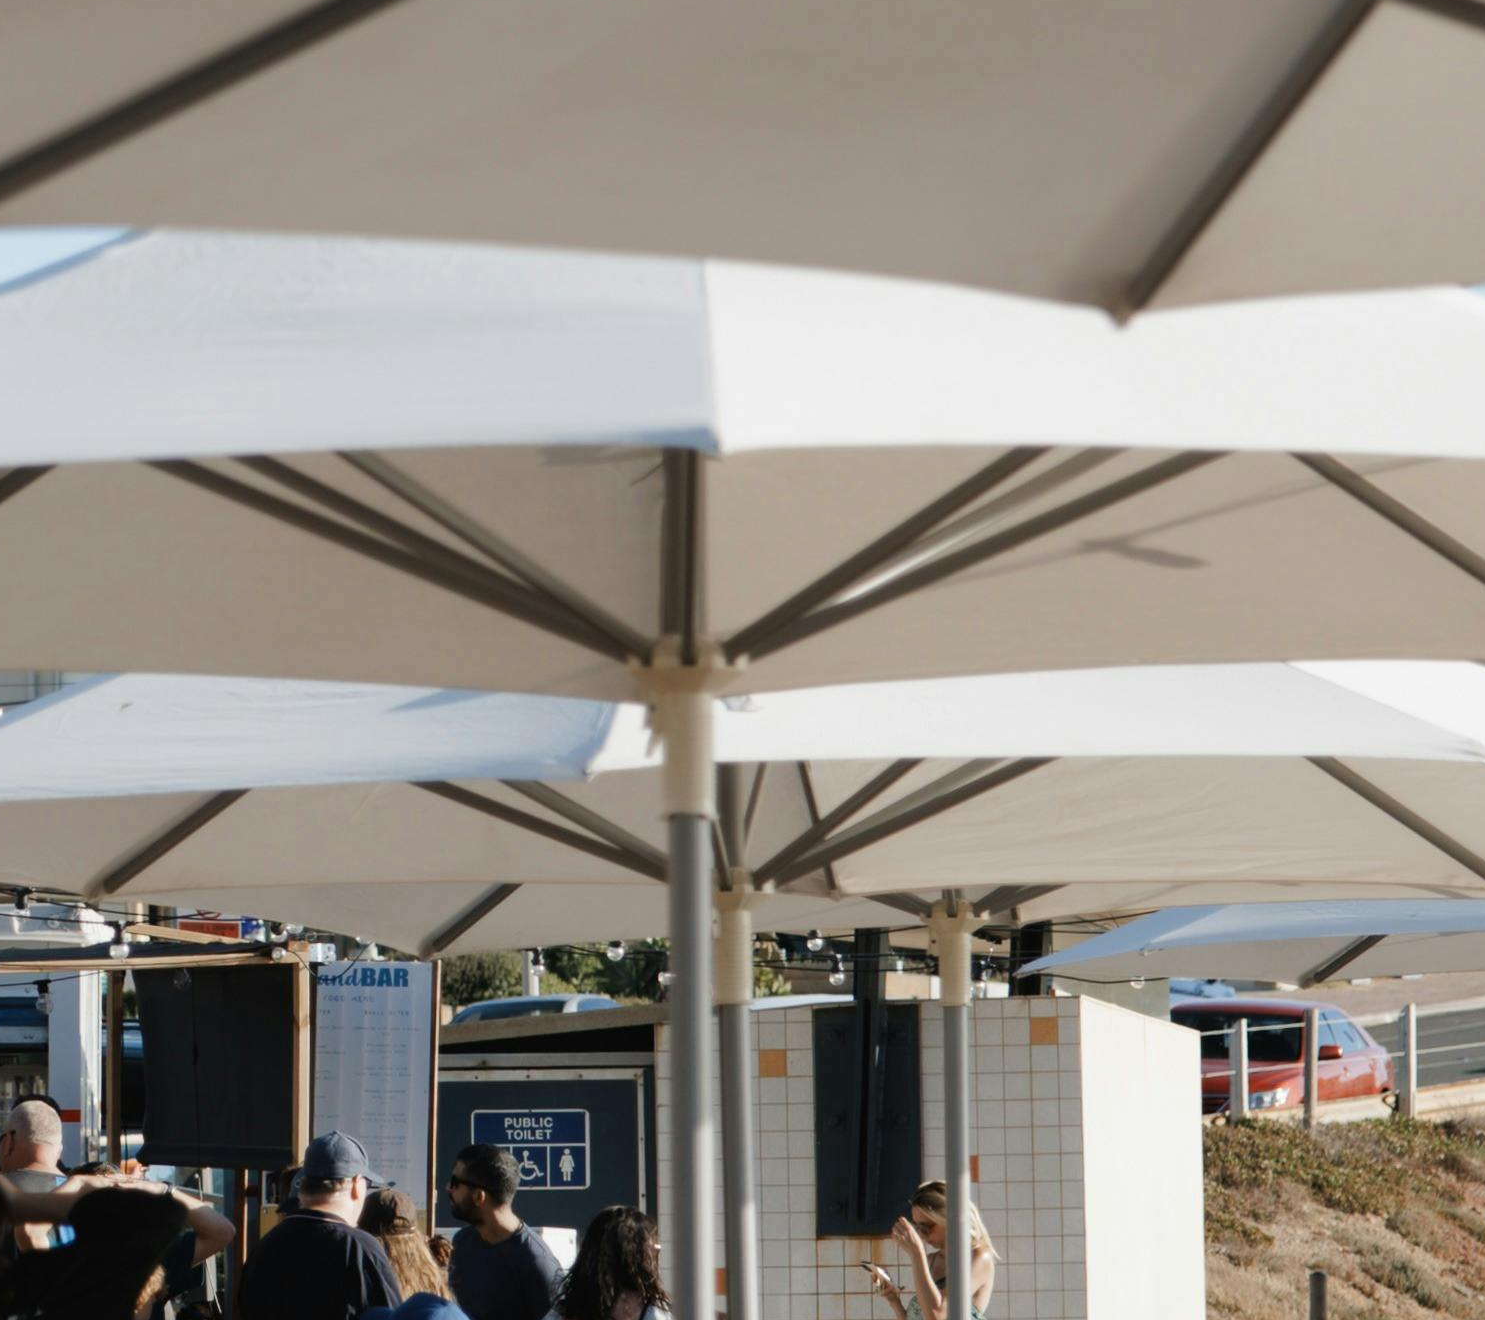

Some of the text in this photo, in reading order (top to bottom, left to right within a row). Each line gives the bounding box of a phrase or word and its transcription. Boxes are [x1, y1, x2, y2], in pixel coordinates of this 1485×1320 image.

[317, 967, 409, 987] andBAR
[503, 1117, 553, 1128] PUBLIC
[505, 1129, 553, 1140] TOILET
